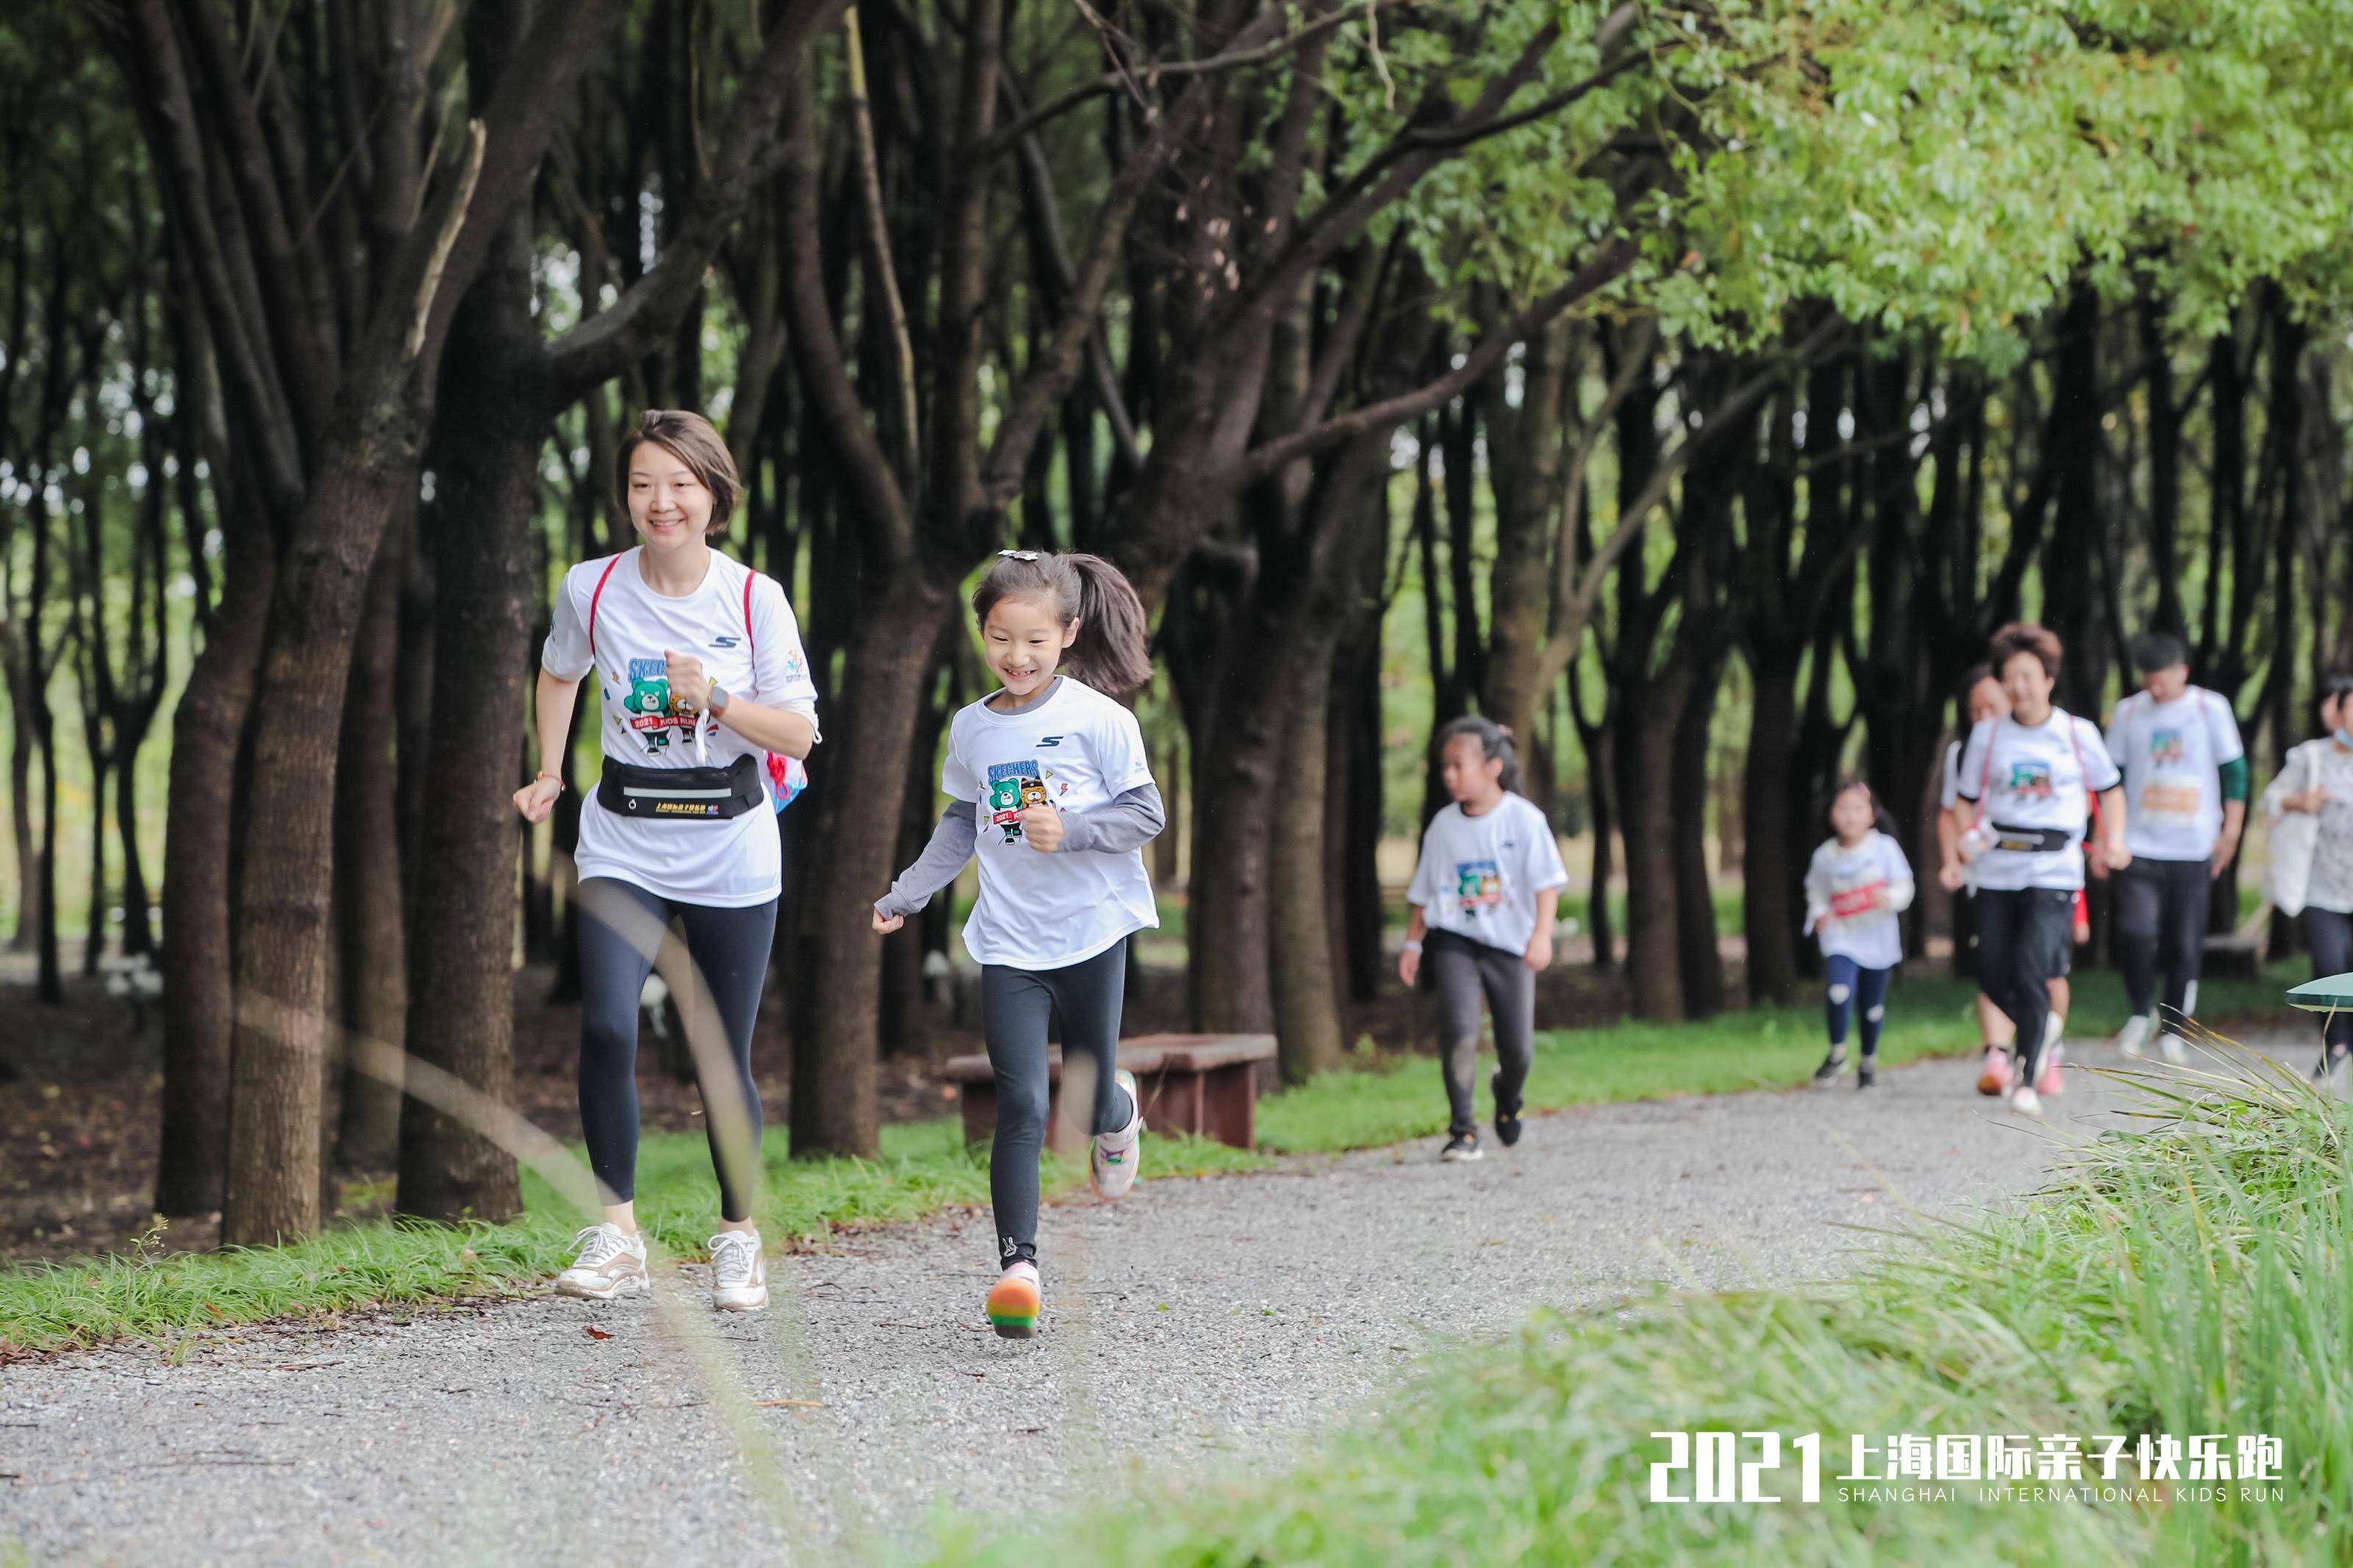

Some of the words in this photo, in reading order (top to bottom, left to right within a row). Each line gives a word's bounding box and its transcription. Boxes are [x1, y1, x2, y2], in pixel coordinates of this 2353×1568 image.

[628, 658, 666, 682] SKEC
[635, 717, 653, 727] 2021
[660, 717, 679, 726] KIDS
[680, 717, 696, 726] RUN
[988, 759, 1040, 786] SKECHERS
[996, 812, 1009, 822] 2021
